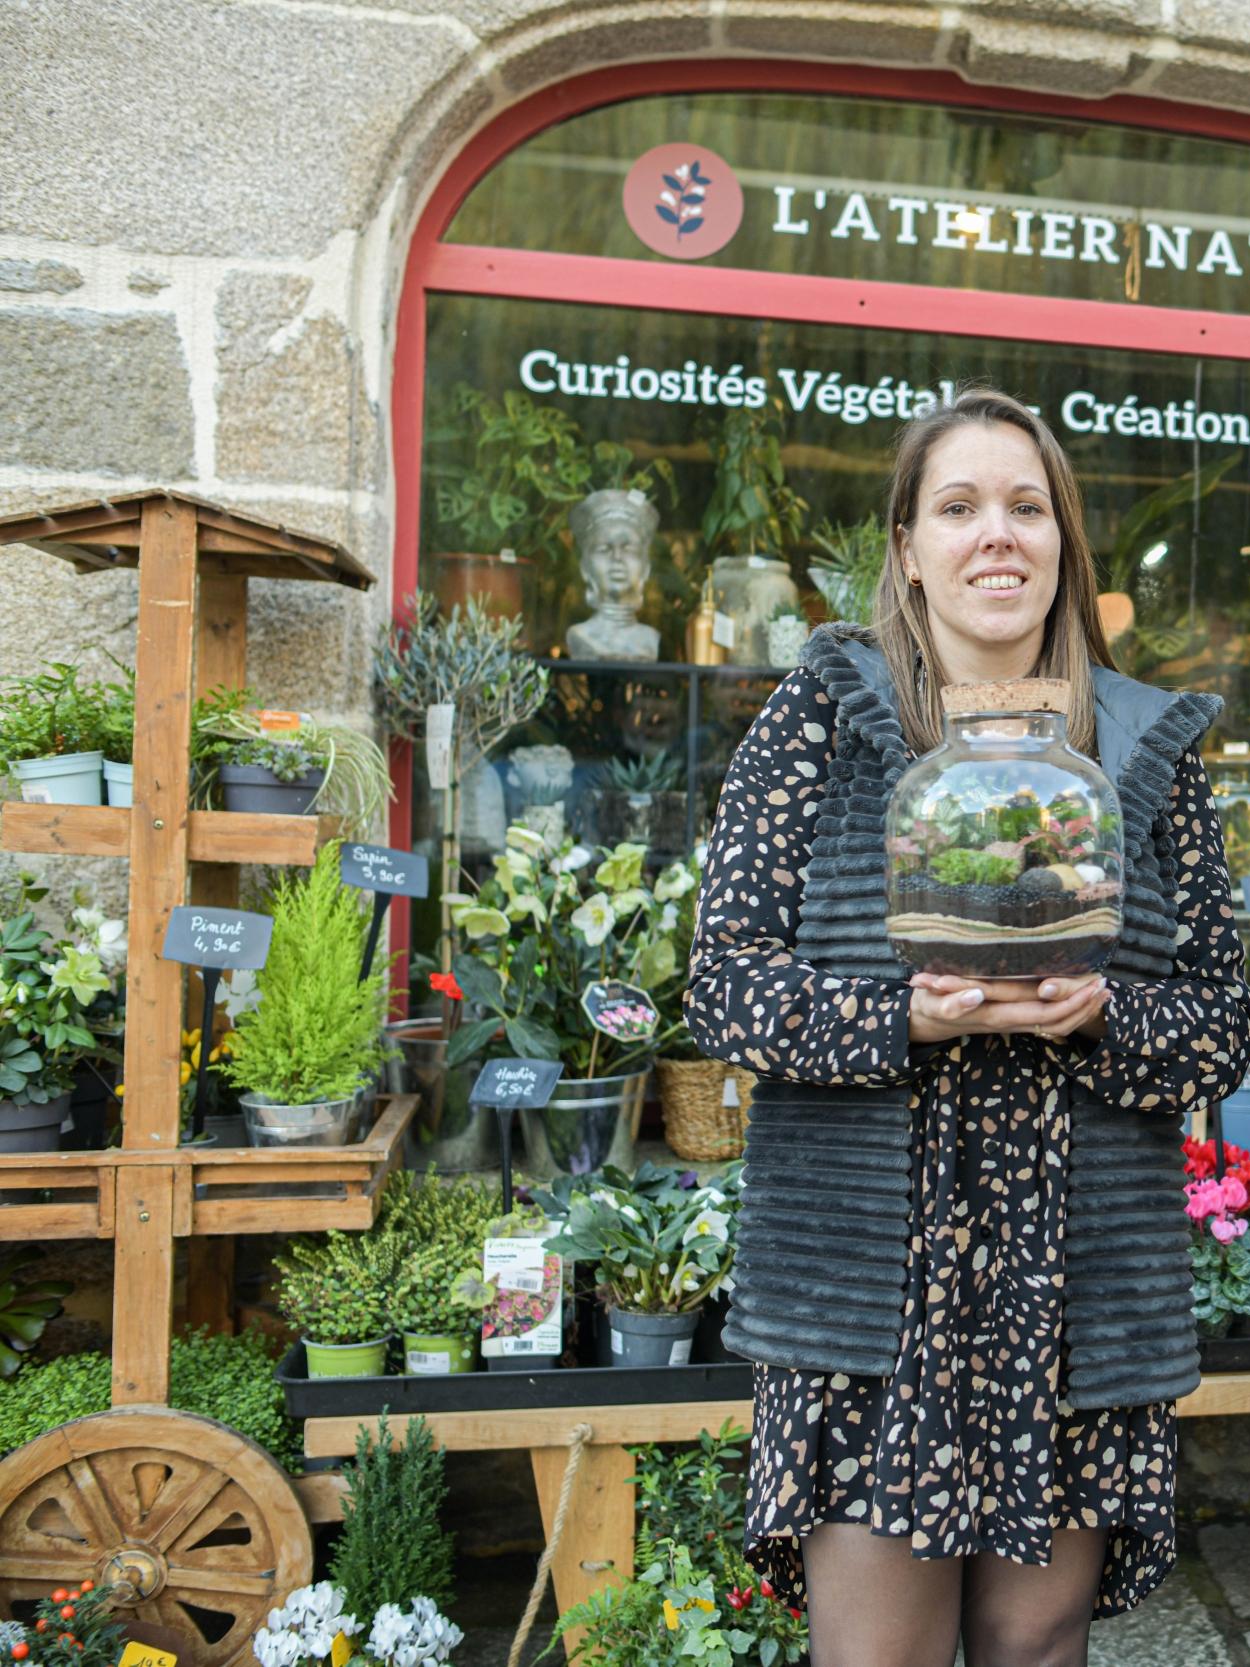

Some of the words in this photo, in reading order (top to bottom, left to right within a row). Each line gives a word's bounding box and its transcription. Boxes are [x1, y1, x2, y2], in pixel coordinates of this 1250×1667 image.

[773, 185, 1120, 265] L'ATELIER
[519, 350, 768, 409] Curiosités
[777, 367, 957, 424] Végétal
[353, 846, 392, 868] Sapin
[191, 916, 245, 936] Piment
